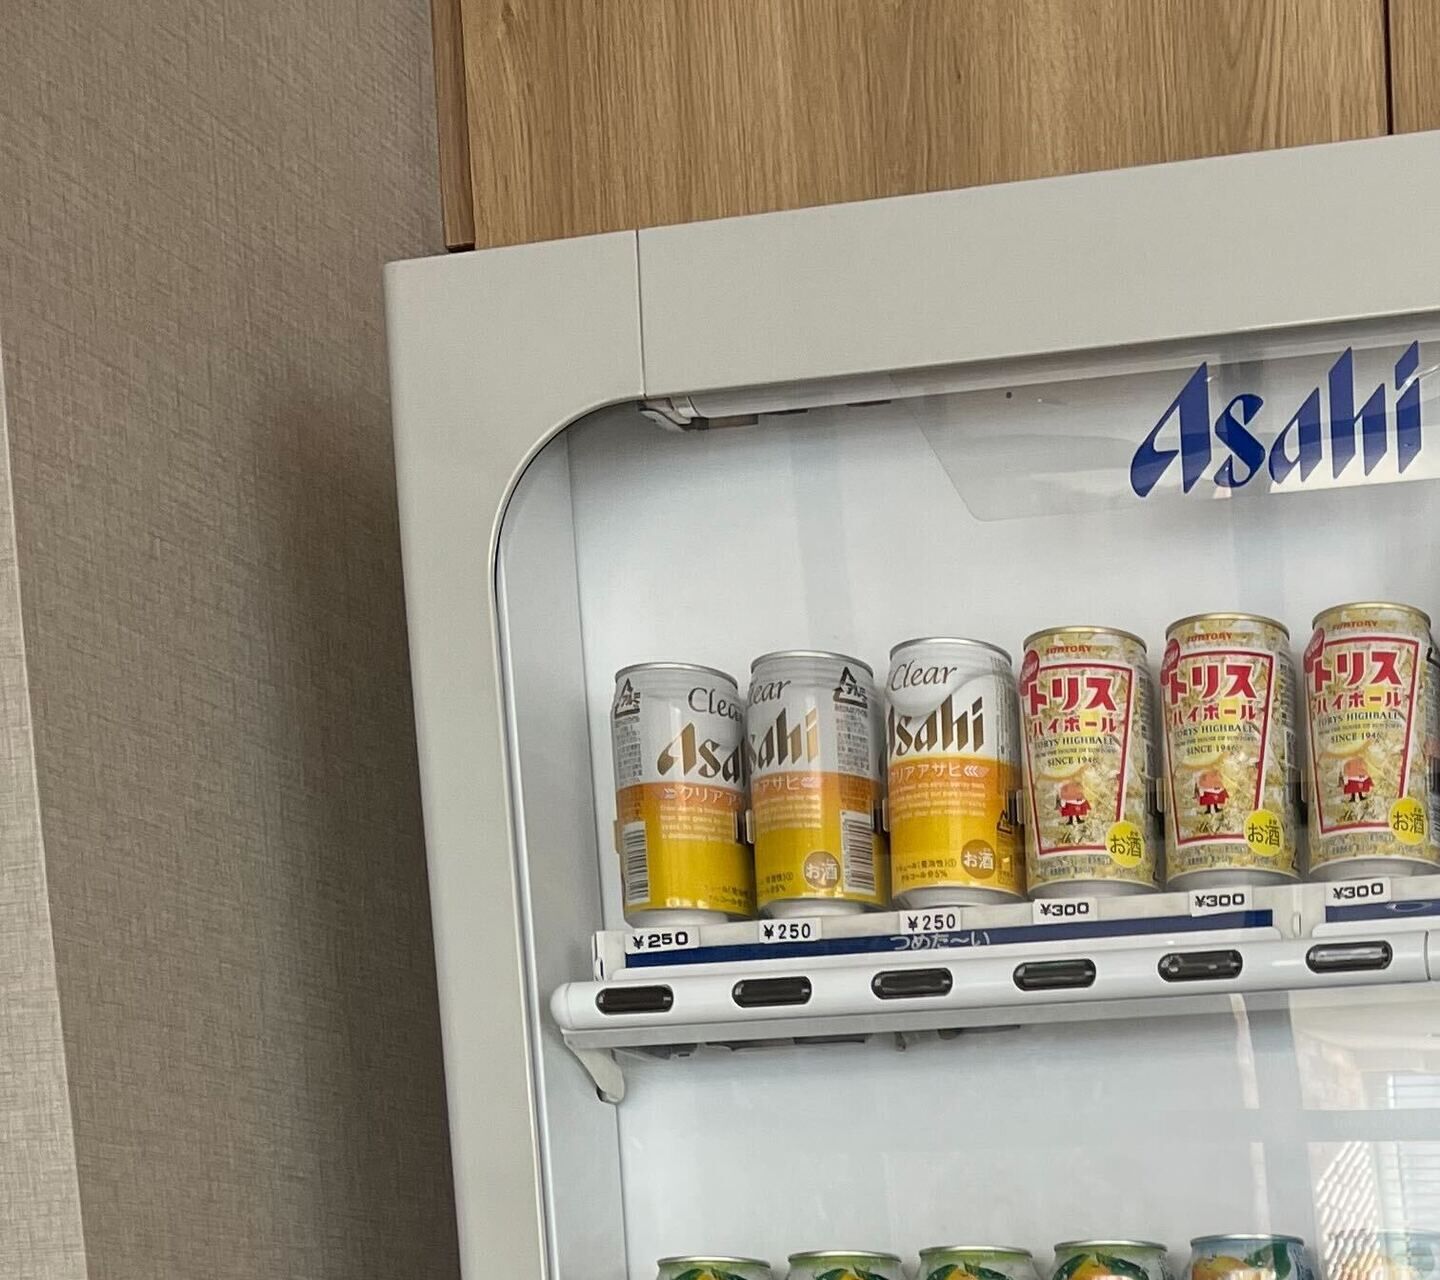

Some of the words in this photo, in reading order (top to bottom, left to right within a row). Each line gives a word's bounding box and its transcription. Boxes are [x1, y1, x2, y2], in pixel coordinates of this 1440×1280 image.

[1130, 340, 1422, 498] Asahi
[891, 660, 957, 692] Clear
[1315, 652, 1402, 693] トリス
[1170, 665, 1257, 705] トリス
[1030, 677, 1117, 716] トリス
[1316, 692, 1402, 714] ハイボール
[1173, 704, 1256, 725] ハイボール
[1033, 717, 1117, 737] ハイボール
[1331, 732, 1357, 743] SINCE
[1187, 744, 1212, 755] SINCE
[1047, 756, 1074, 767] SINCE
[1393, 810, 1424, 835] お酒
[1248, 822, 1280, 847] お酒
[1110, 833, 1142, 858] お酒
[806, 859, 838, 881] お酒
[964, 850, 994, 872] お酒
[1195, 893, 1245, 908] ¥300
[1333, 882, 1383, 900] ¥300
[1040, 902, 1089, 917] ¥300
[764, 923, 811, 940] ¥250
[908, 914, 955, 931] ¥250
[633, 931, 688, 949] ¥250
